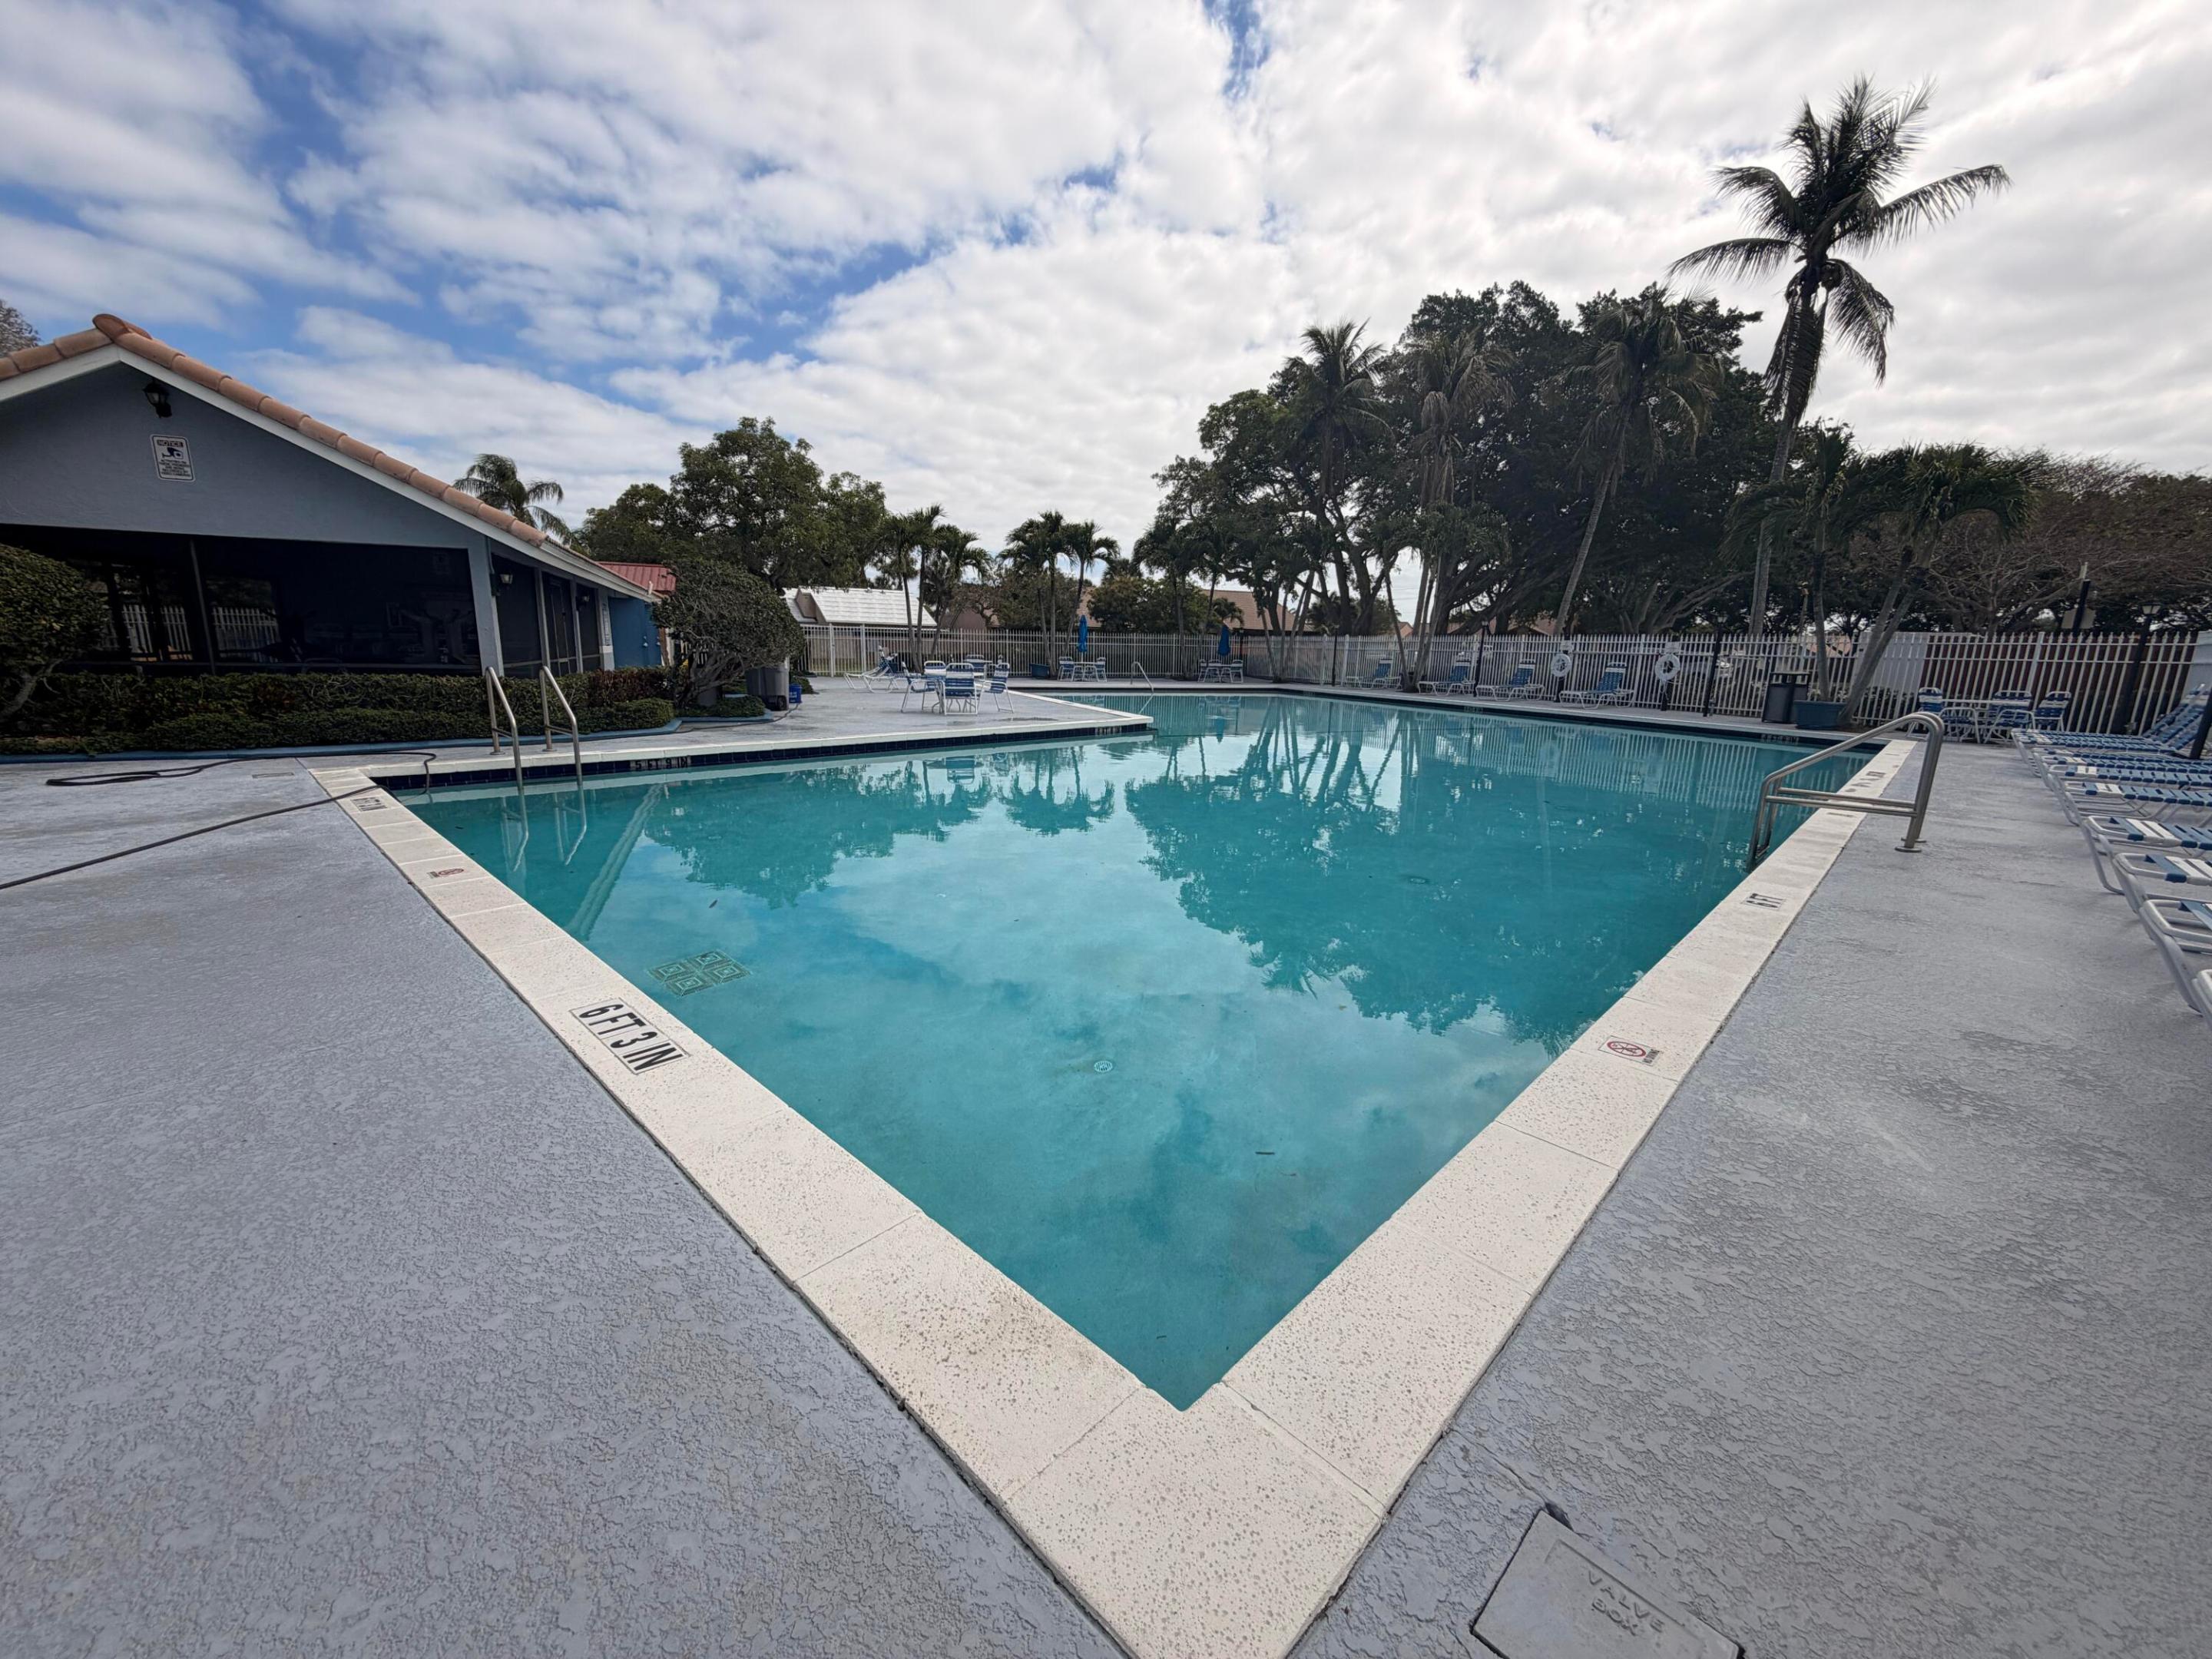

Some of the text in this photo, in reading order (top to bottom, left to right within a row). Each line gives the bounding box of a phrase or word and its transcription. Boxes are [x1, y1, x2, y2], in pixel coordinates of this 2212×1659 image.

[1749, 892, 1786, 904] FT
[578, 1003, 684, 1071] 6 FT 3 IN
[1588, 1571, 1666, 1634] VALVE
[1591, 1598, 1638, 1636] BOX
